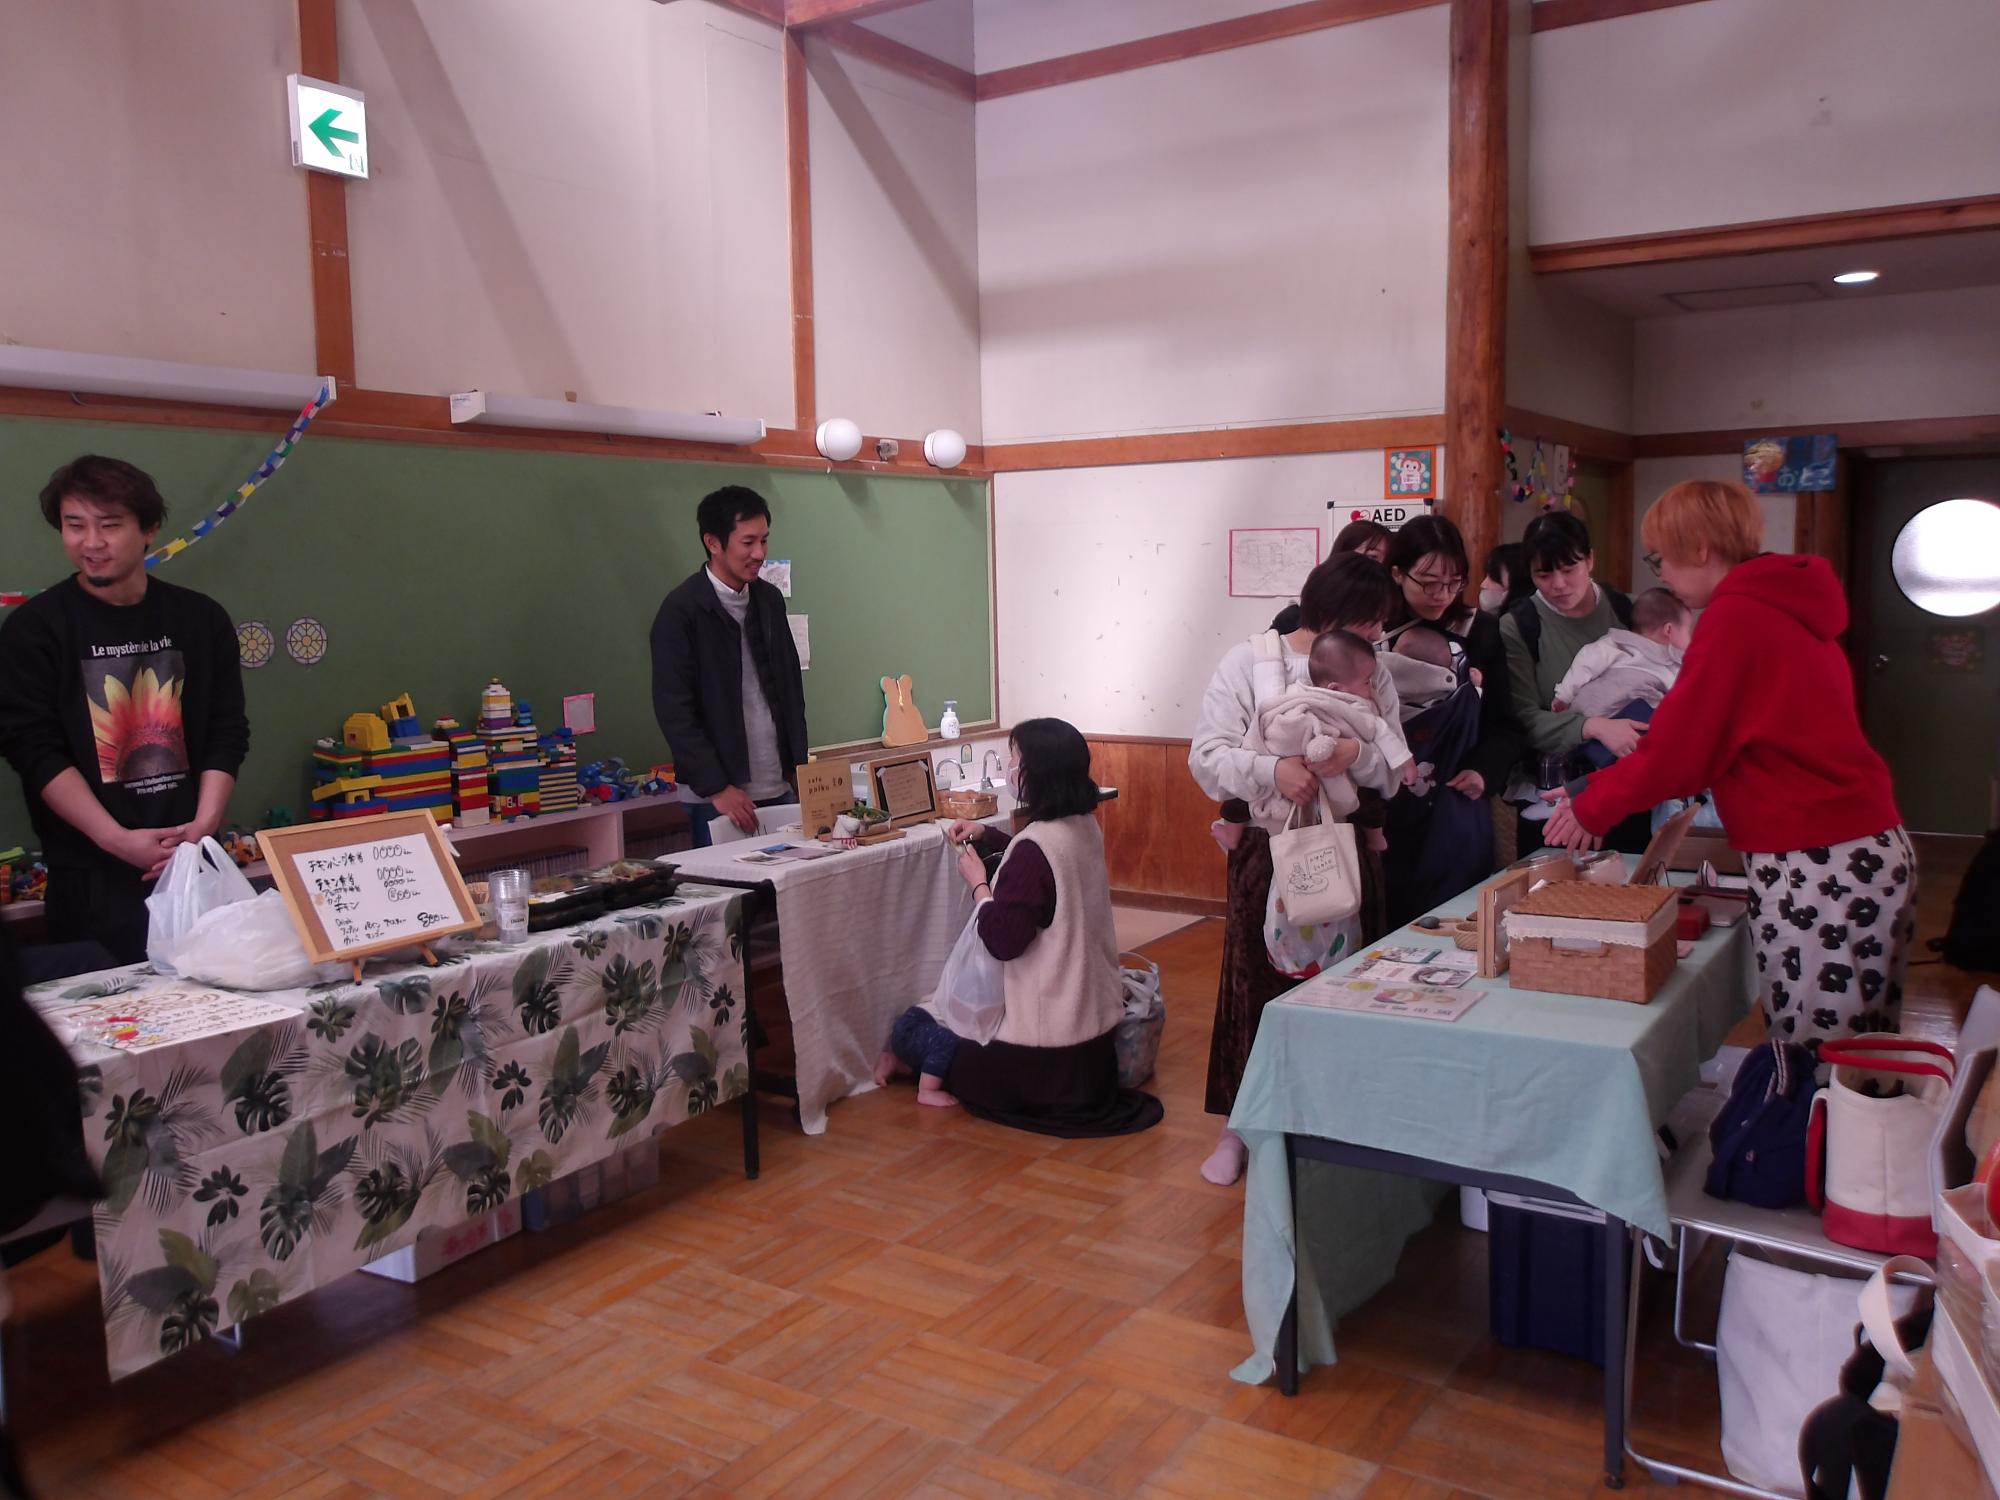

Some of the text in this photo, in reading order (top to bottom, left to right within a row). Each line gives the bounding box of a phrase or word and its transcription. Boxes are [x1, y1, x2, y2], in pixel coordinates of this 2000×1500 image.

[1372, 508, 1406, 523] AED
[91, 645, 105, 657] Le
[150, 639, 159, 651] la
[159, 635, 172, 648] vie
